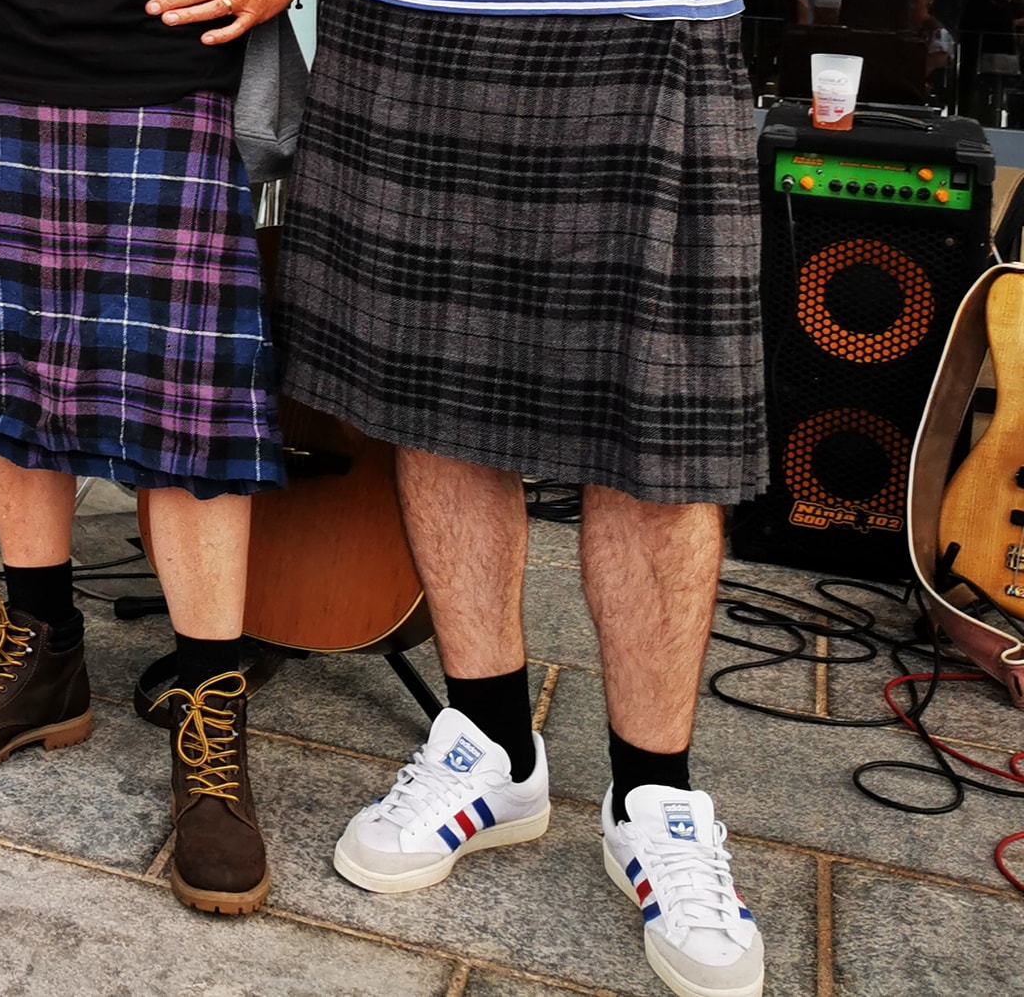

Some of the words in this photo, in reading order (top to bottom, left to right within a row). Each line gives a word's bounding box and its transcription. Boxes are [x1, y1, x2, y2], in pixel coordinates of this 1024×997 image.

[792, 512, 827, 526] 500
[796, 503, 856, 521] Ninja
[866, 515, 900, 528] 102
